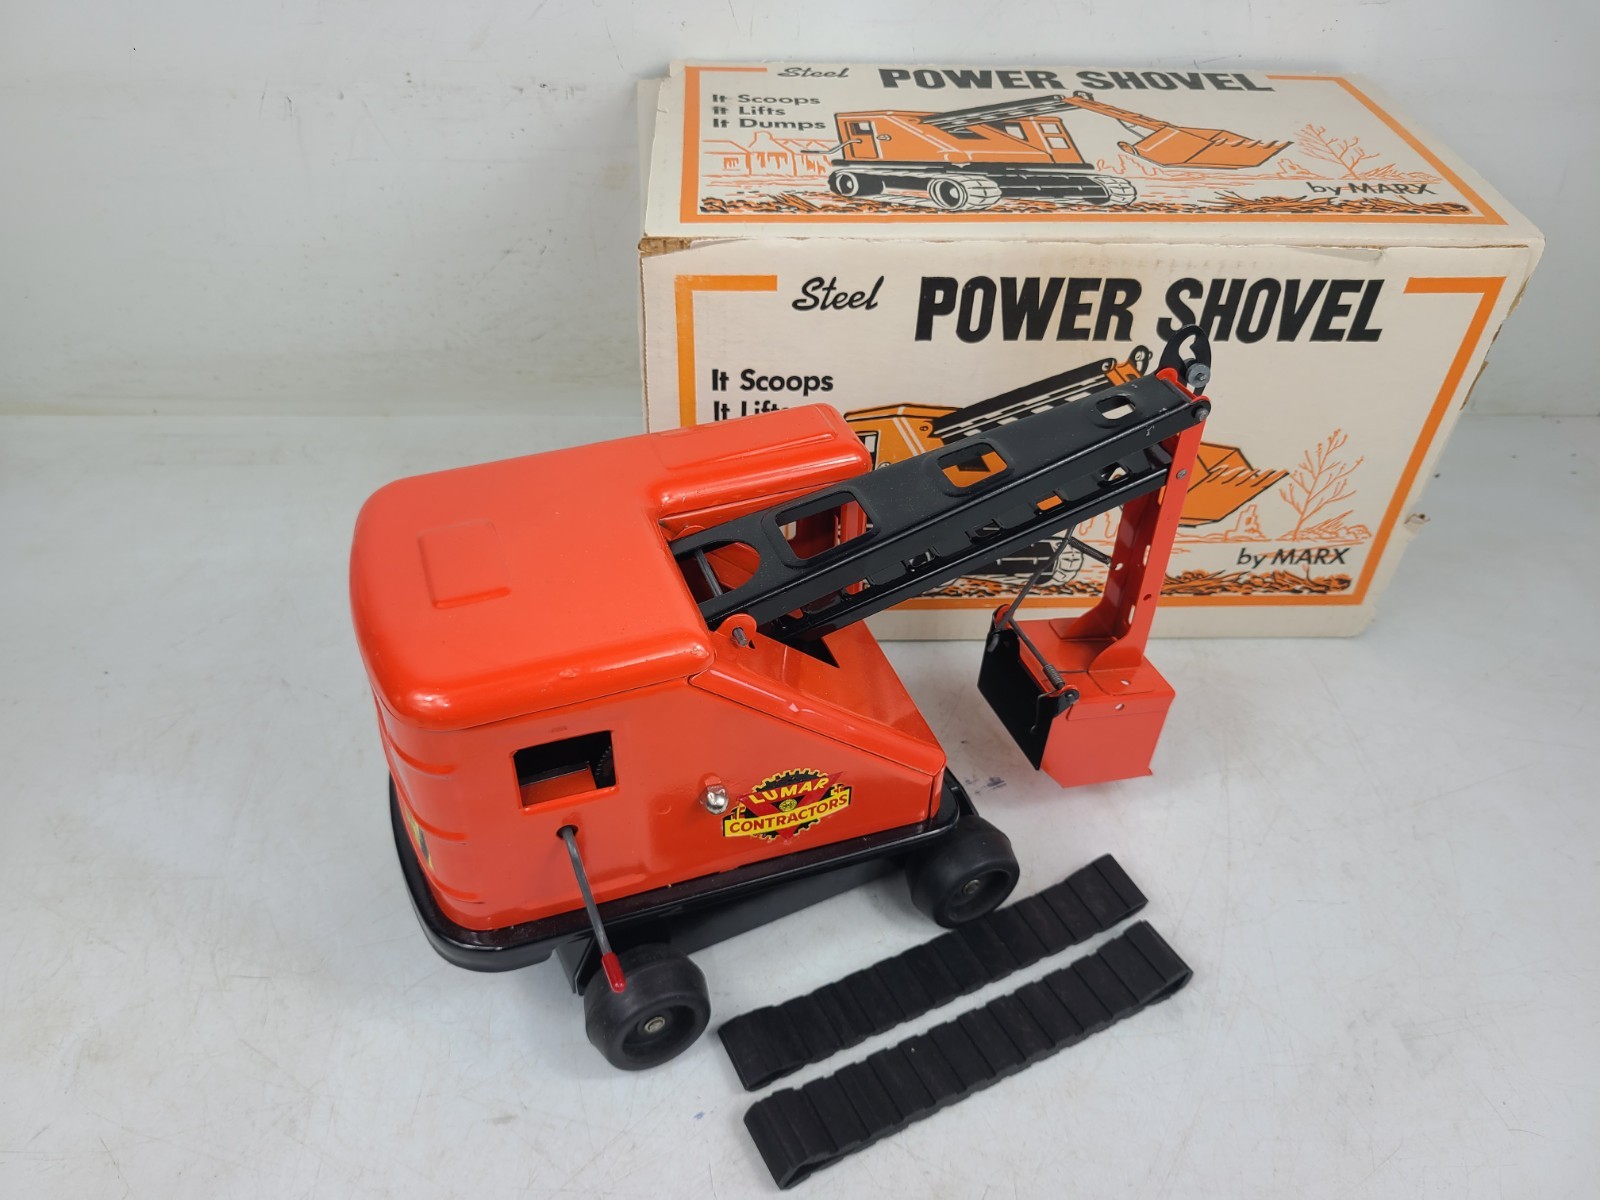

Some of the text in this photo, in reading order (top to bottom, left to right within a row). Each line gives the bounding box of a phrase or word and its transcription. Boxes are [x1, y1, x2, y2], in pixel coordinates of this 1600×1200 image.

[777, 67, 1275, 92] Steel POWER SHOVEL
[712, 94, 821, 106] It Scoops
[713, 106, 786, 115] It Lifts
[713, 118, 826, 131] It Dumps
[1306, 182, 1438, 195] by MARX
[791, 275, 1385, 344] Steel POWER SHOVEL
[711, 368, 834, 396] It Scoops
[713, 400, 788, 422] It Lift
[1236, 547, 1351, 569] by MARX
[748, 777, 829, 805] LUMAR
[729, 794, 848, 834] CONTRACTORS
